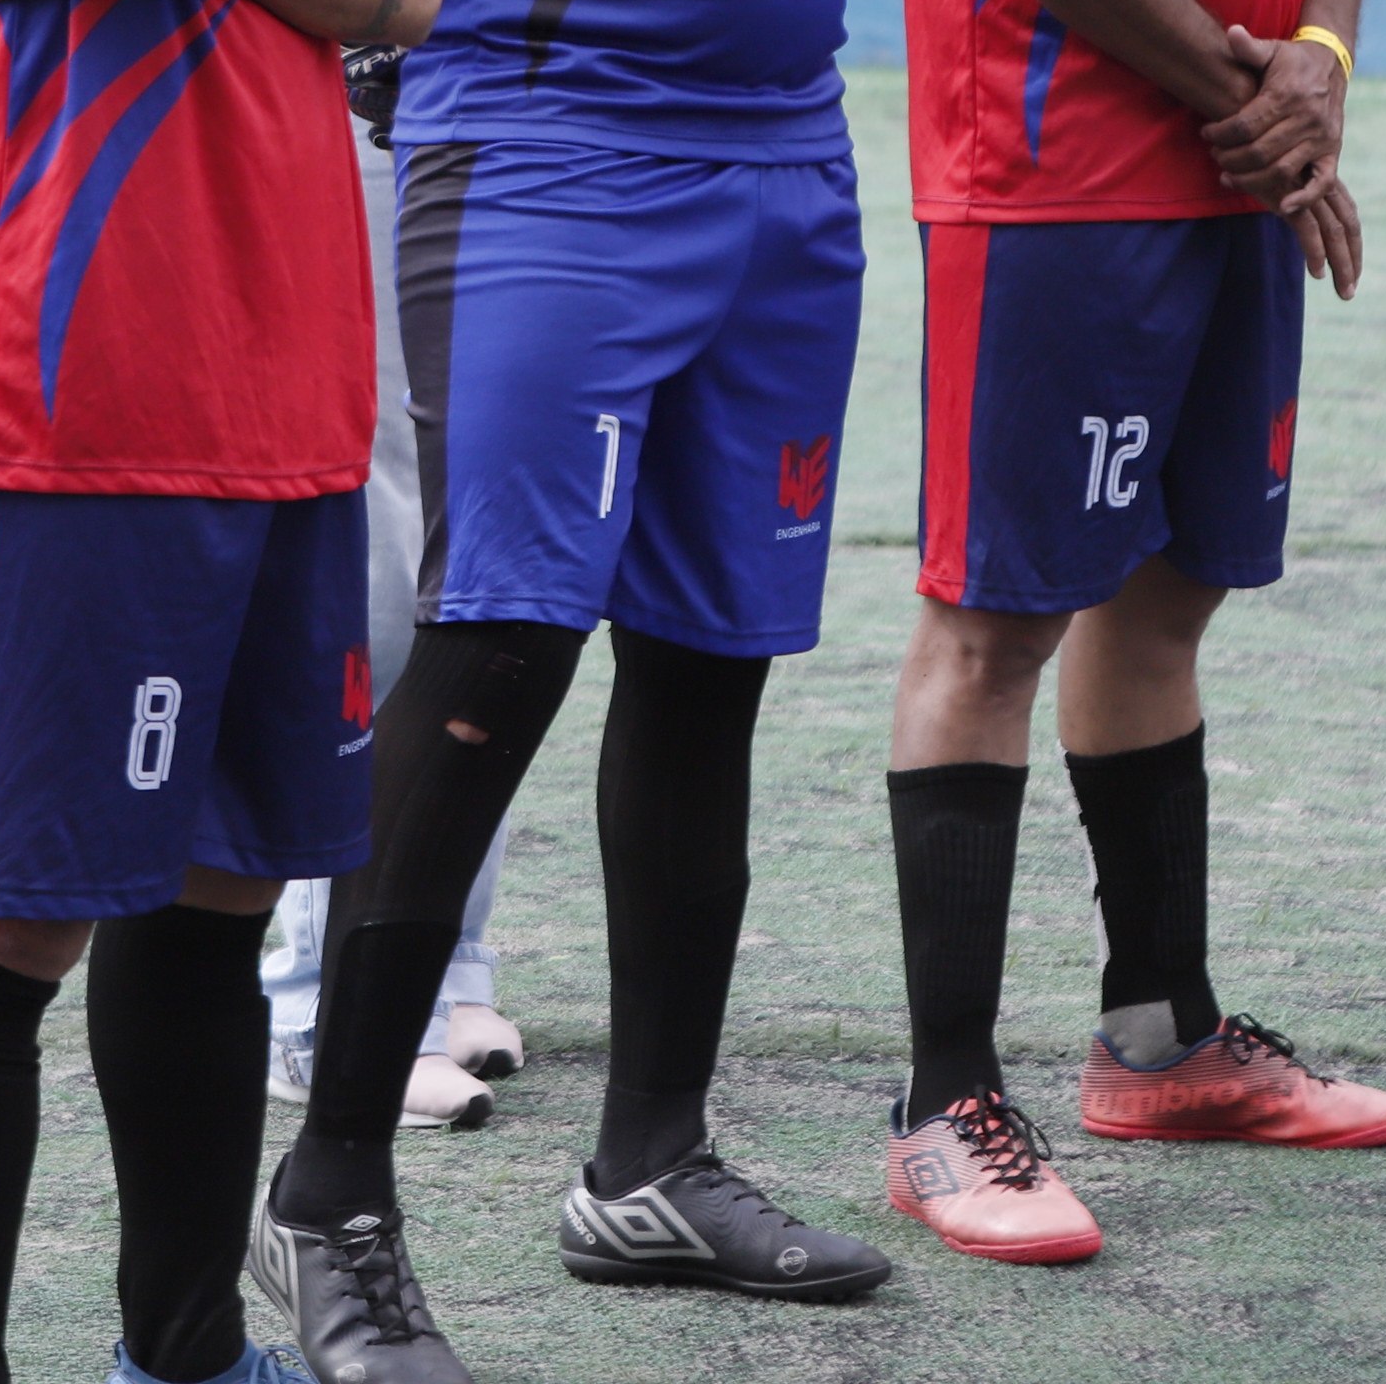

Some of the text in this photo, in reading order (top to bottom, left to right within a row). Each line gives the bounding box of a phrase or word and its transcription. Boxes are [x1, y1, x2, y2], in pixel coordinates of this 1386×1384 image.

[596, 414, 620, 519] 1
[1081, 415, 1150, 511] 12
[127, 676, 182, 790] 8
